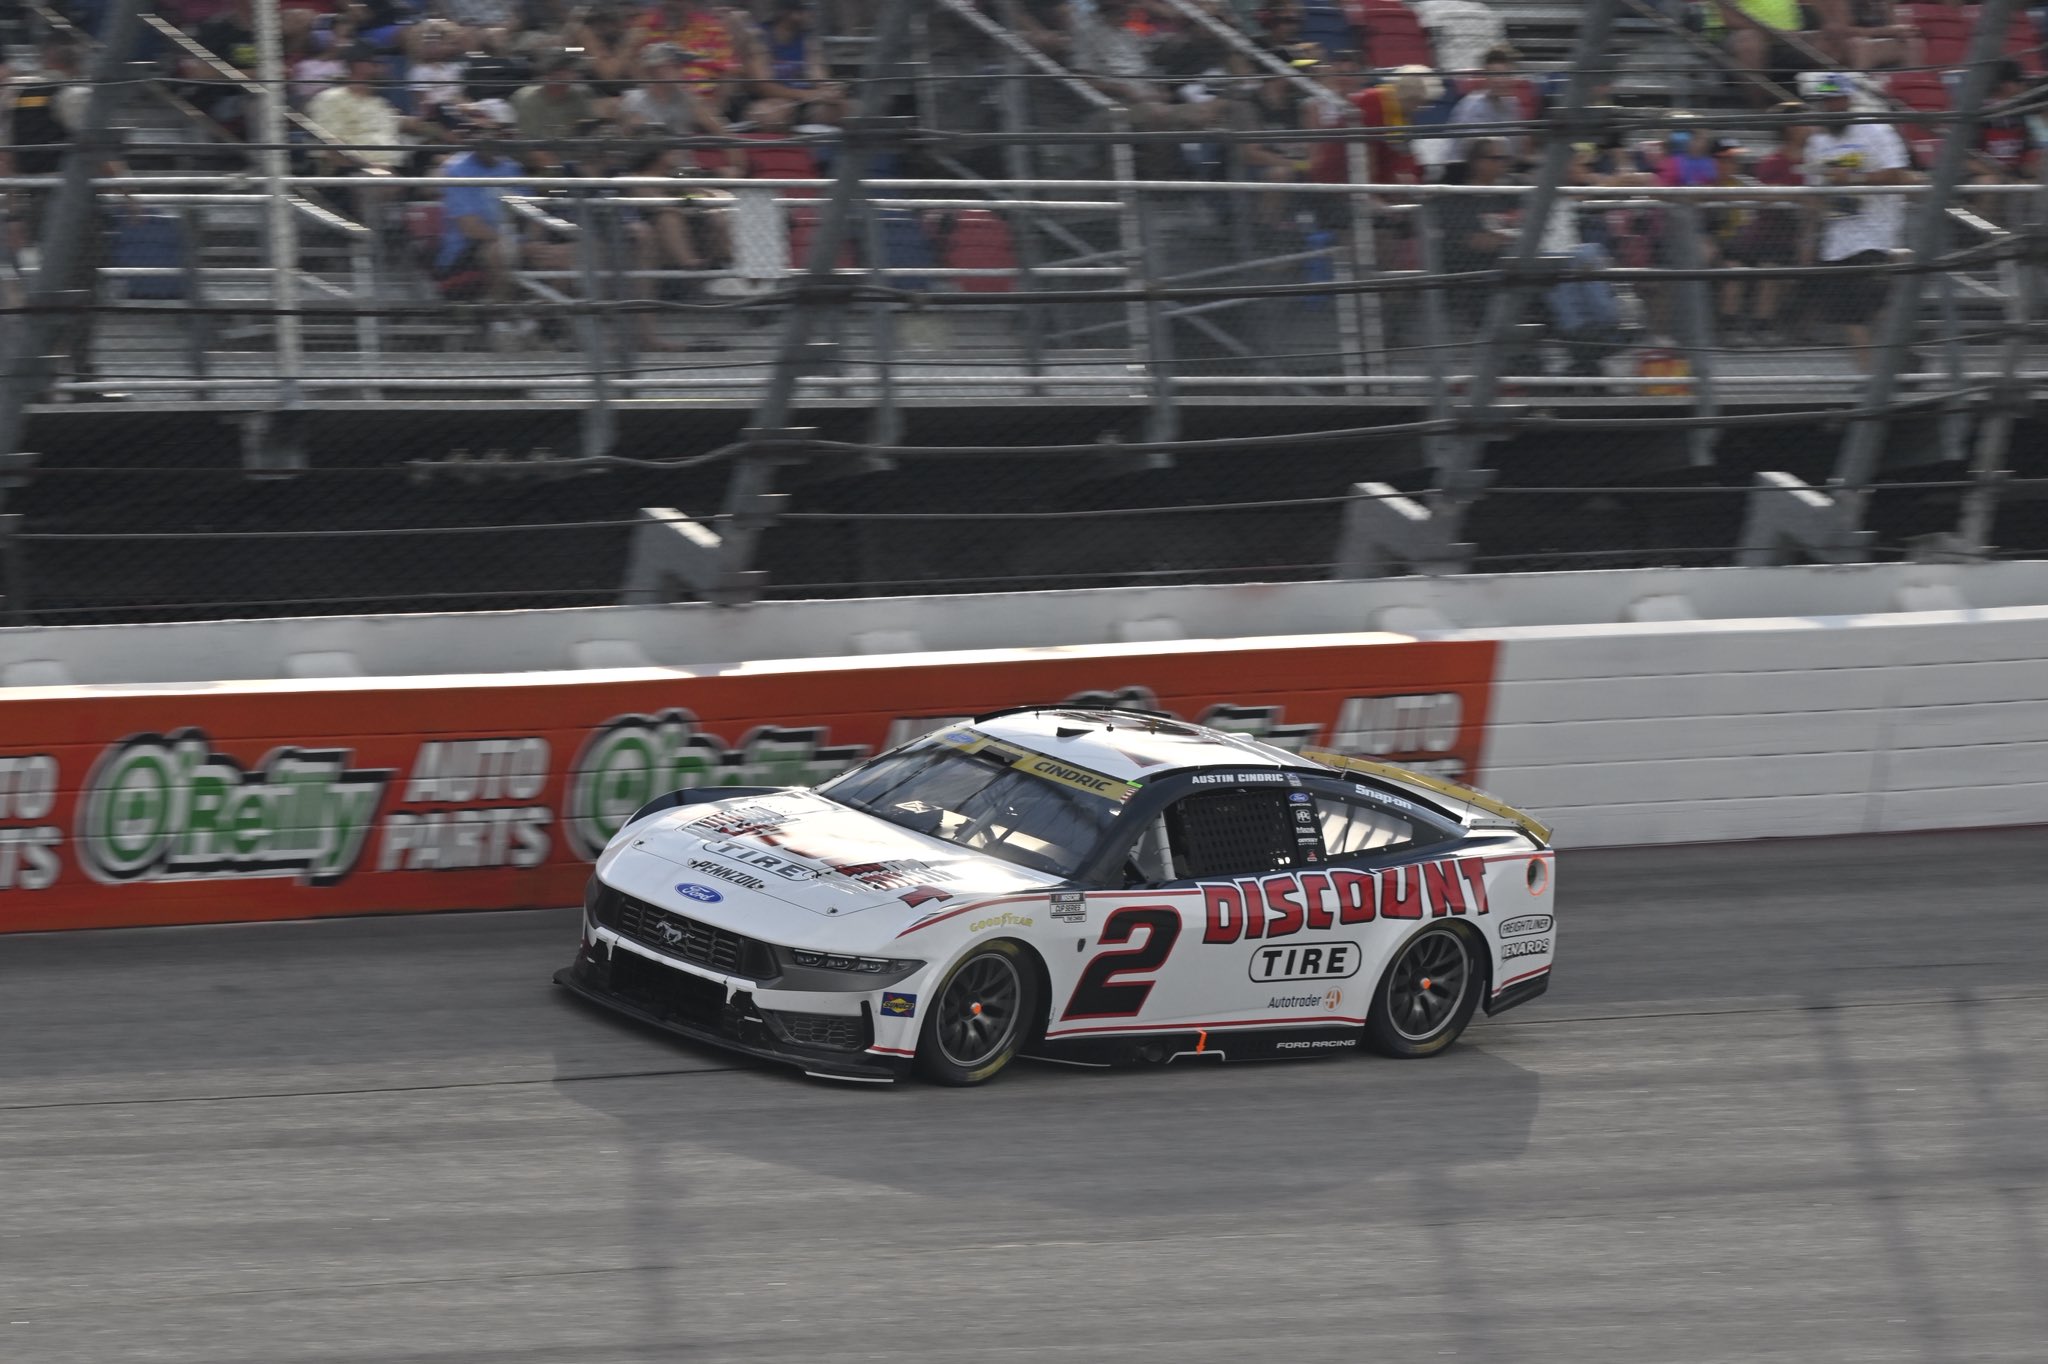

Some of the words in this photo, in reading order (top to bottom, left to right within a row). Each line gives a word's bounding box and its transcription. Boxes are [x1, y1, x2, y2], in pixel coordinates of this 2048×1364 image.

[1334, 693, 1462, 755] AUTO
[403, 737, 551, 802] AUTO
[1034, 761, 1112, 792] CINDRIC
[1192, 774, 1235, 785] AUSTIN
[1238, 773, 1284, 783] CINDRIC
[92, 735, 392, 880] O'Reilly
[1355, 784, 1412, 810] Snap-on
[379, 806, 554, 872] PARTS
[696, 860, 761, 889] PENNZOIL
[717, 842, 807, 877] TIRE
[679, 885, 718, 902] Ford
[1201, 857, 1490, 945] DISCOUNT
[969, 912, 1034, 933] GOODYEAR
[1060, 904, 1182, 1022] 2
[1262, 947, 1348, 977] TIRE
[1267, 995, 1322, 1009] Autotrader
